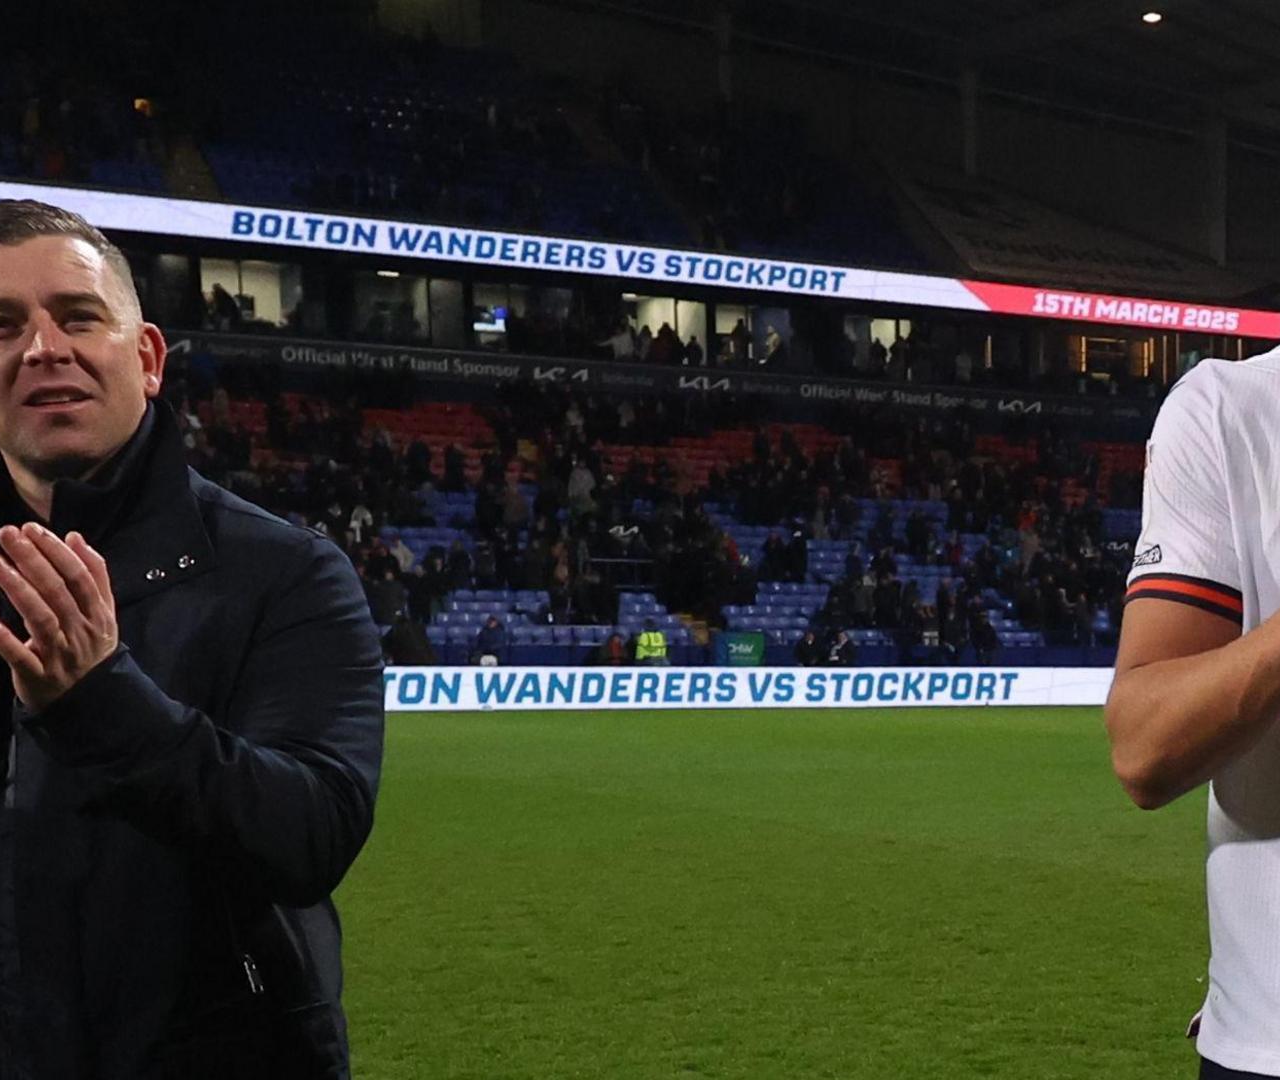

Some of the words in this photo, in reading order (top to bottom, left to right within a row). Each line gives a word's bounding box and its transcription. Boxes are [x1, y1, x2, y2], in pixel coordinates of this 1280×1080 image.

[231, 210, 378, 248] BOLTON
[387, 224, 607, 271] WANDERERS
[614, 248, 657, 276] VS
[663, 253, 848, 294] STOCKPORT
[1032, 292, 1087, 316] 15TH
[1094, 298, 1177, 325] MARCH
[1182, 307, 1241, 331] 2025
[280, 345, 346, 367] Official
[452, 356, 520, 380] Sponsor
[474, 672, 738, 705] WANDERERS
[748, 672, 797, 703] VS
[805, 672, 1020, 702] STOCKPORT
